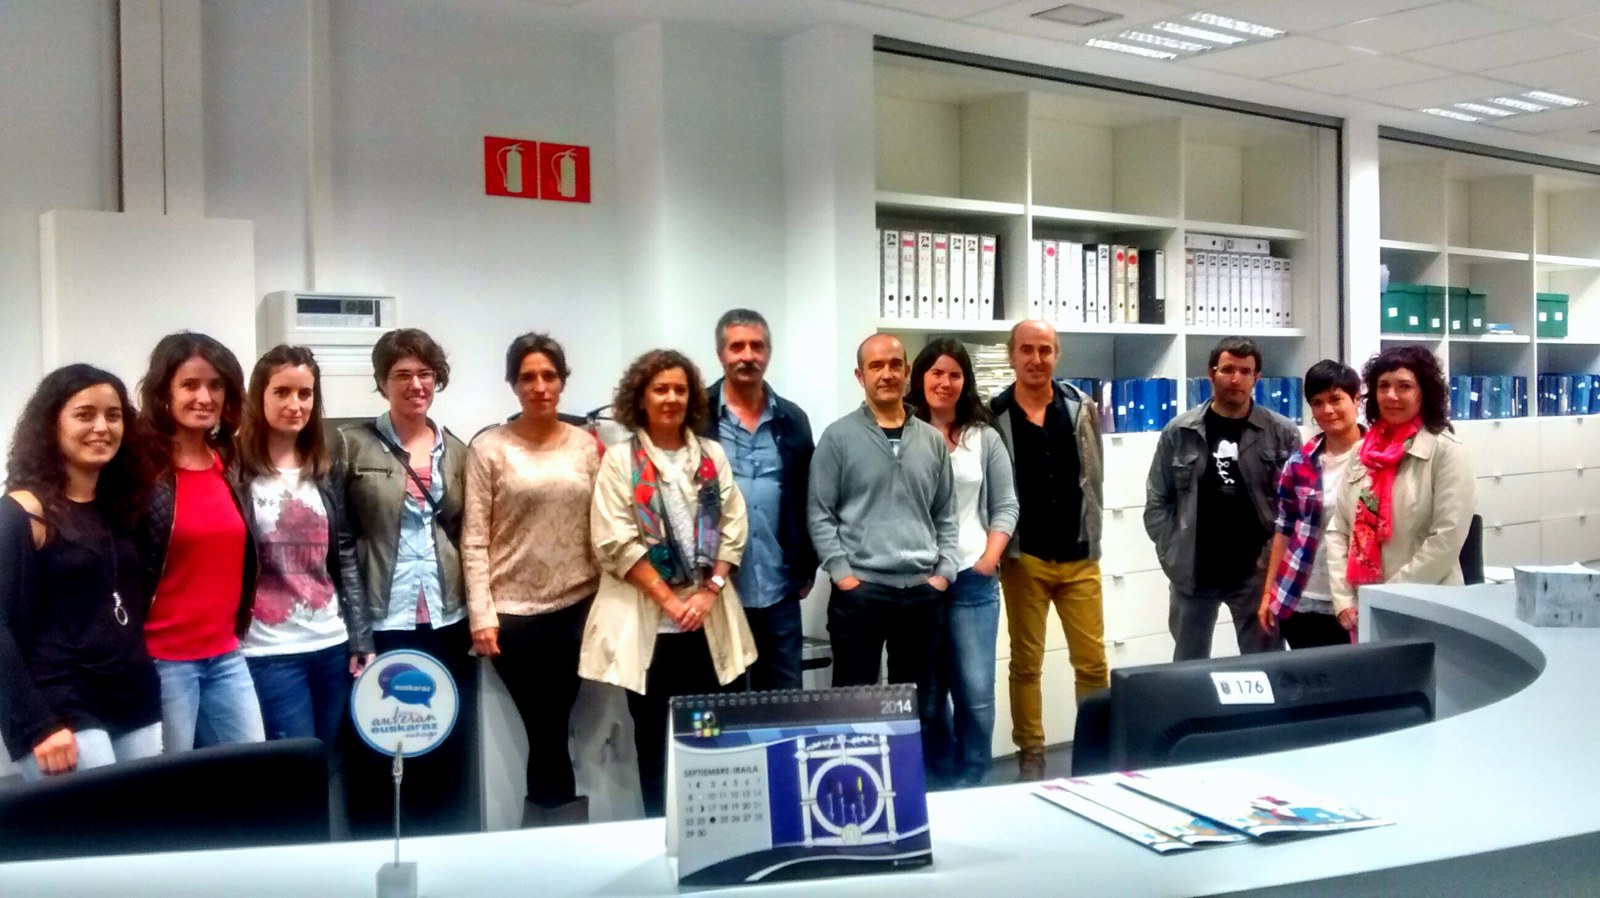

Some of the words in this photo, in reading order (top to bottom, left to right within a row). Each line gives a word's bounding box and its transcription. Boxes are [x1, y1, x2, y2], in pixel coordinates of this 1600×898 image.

[1236, 680, 1264, 695] 176
[880, 699, 912, 715] 2014
[371, 722, 438, 734] euskaraz
